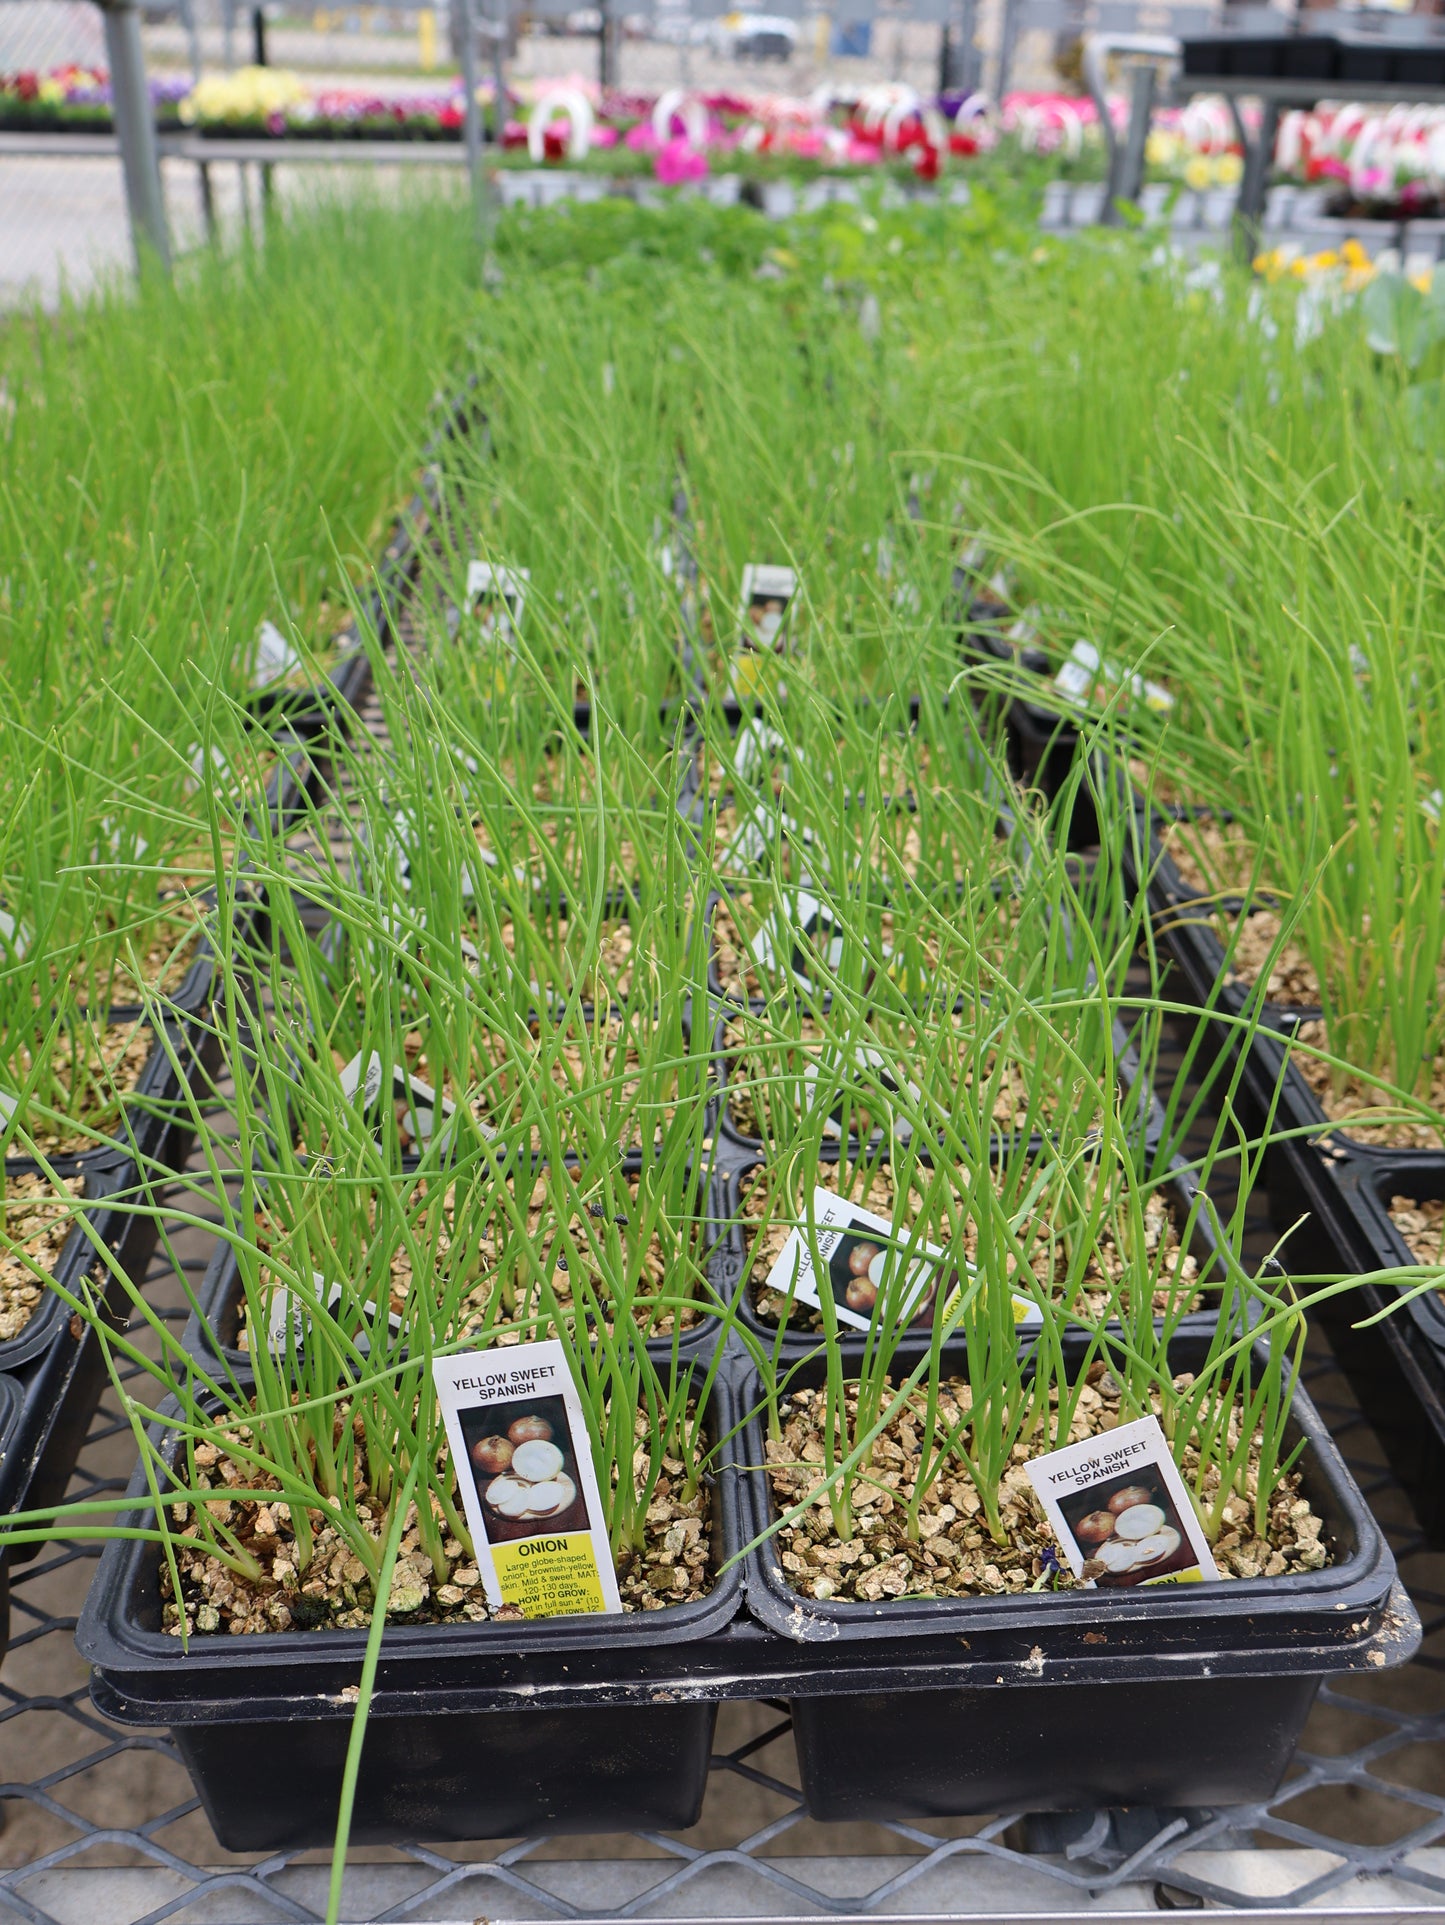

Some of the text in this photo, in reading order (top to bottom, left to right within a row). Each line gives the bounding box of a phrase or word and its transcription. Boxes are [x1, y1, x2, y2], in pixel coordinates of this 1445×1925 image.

[452, 1365, 555, 1391] YELLOW SWEET
[479, 1382, 536, 1400] SPANISH
[1048, 1440, 1147, 1484] YELLOW SWEET
[1075, 1459, 1130, 1486] SPANISH
[518, 1539, 568, 1556] ONION
[506, 1553, 586, 1572] Large globe-shaped
[529, 1563, 594, 1576] brownish-yellow
[521, 1578, 539, 1587] Mild
[577, 1570, 600, 1579] MAT:
[558, 1581, 580, 1590] days.
[518, 1589, 590, 1605] HOW TO GROW:
[544, 1600, 557, 1609] full
[565, 1607, 585, 1615] rows
